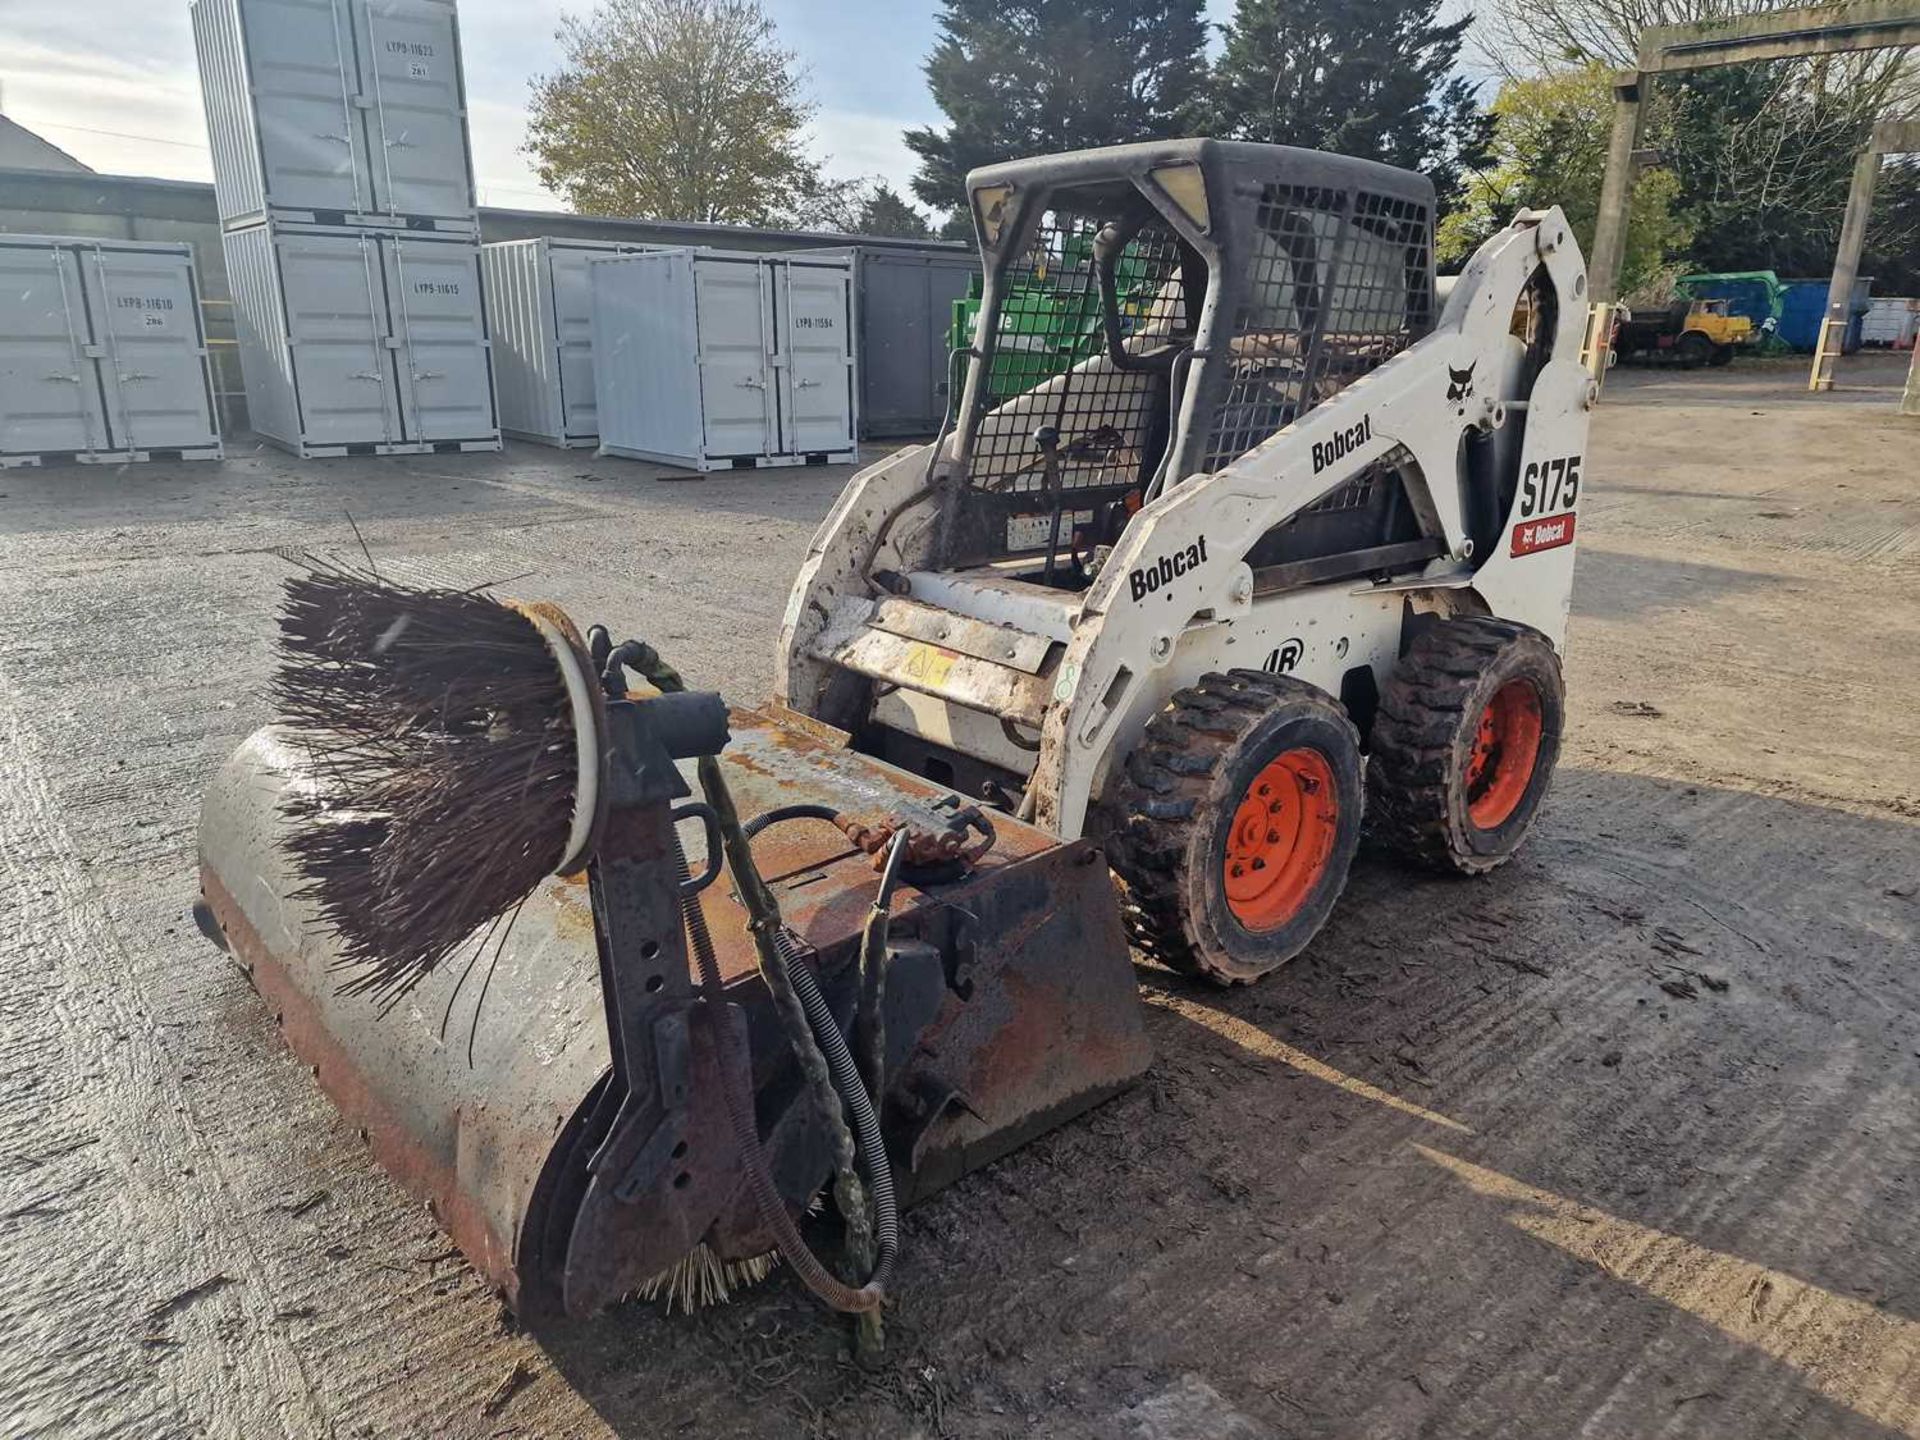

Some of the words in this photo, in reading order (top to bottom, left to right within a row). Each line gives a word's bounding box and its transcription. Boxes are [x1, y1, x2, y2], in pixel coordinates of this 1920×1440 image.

[1312, 413, 1371, 475] Bobcat
[1521, 456, 1581, 517] S175
[1535, 521, 1565, 545] Bobcat
[1129, 534, 1208, 603] Bobcat
[1269, 645, 1298, 673] IR
